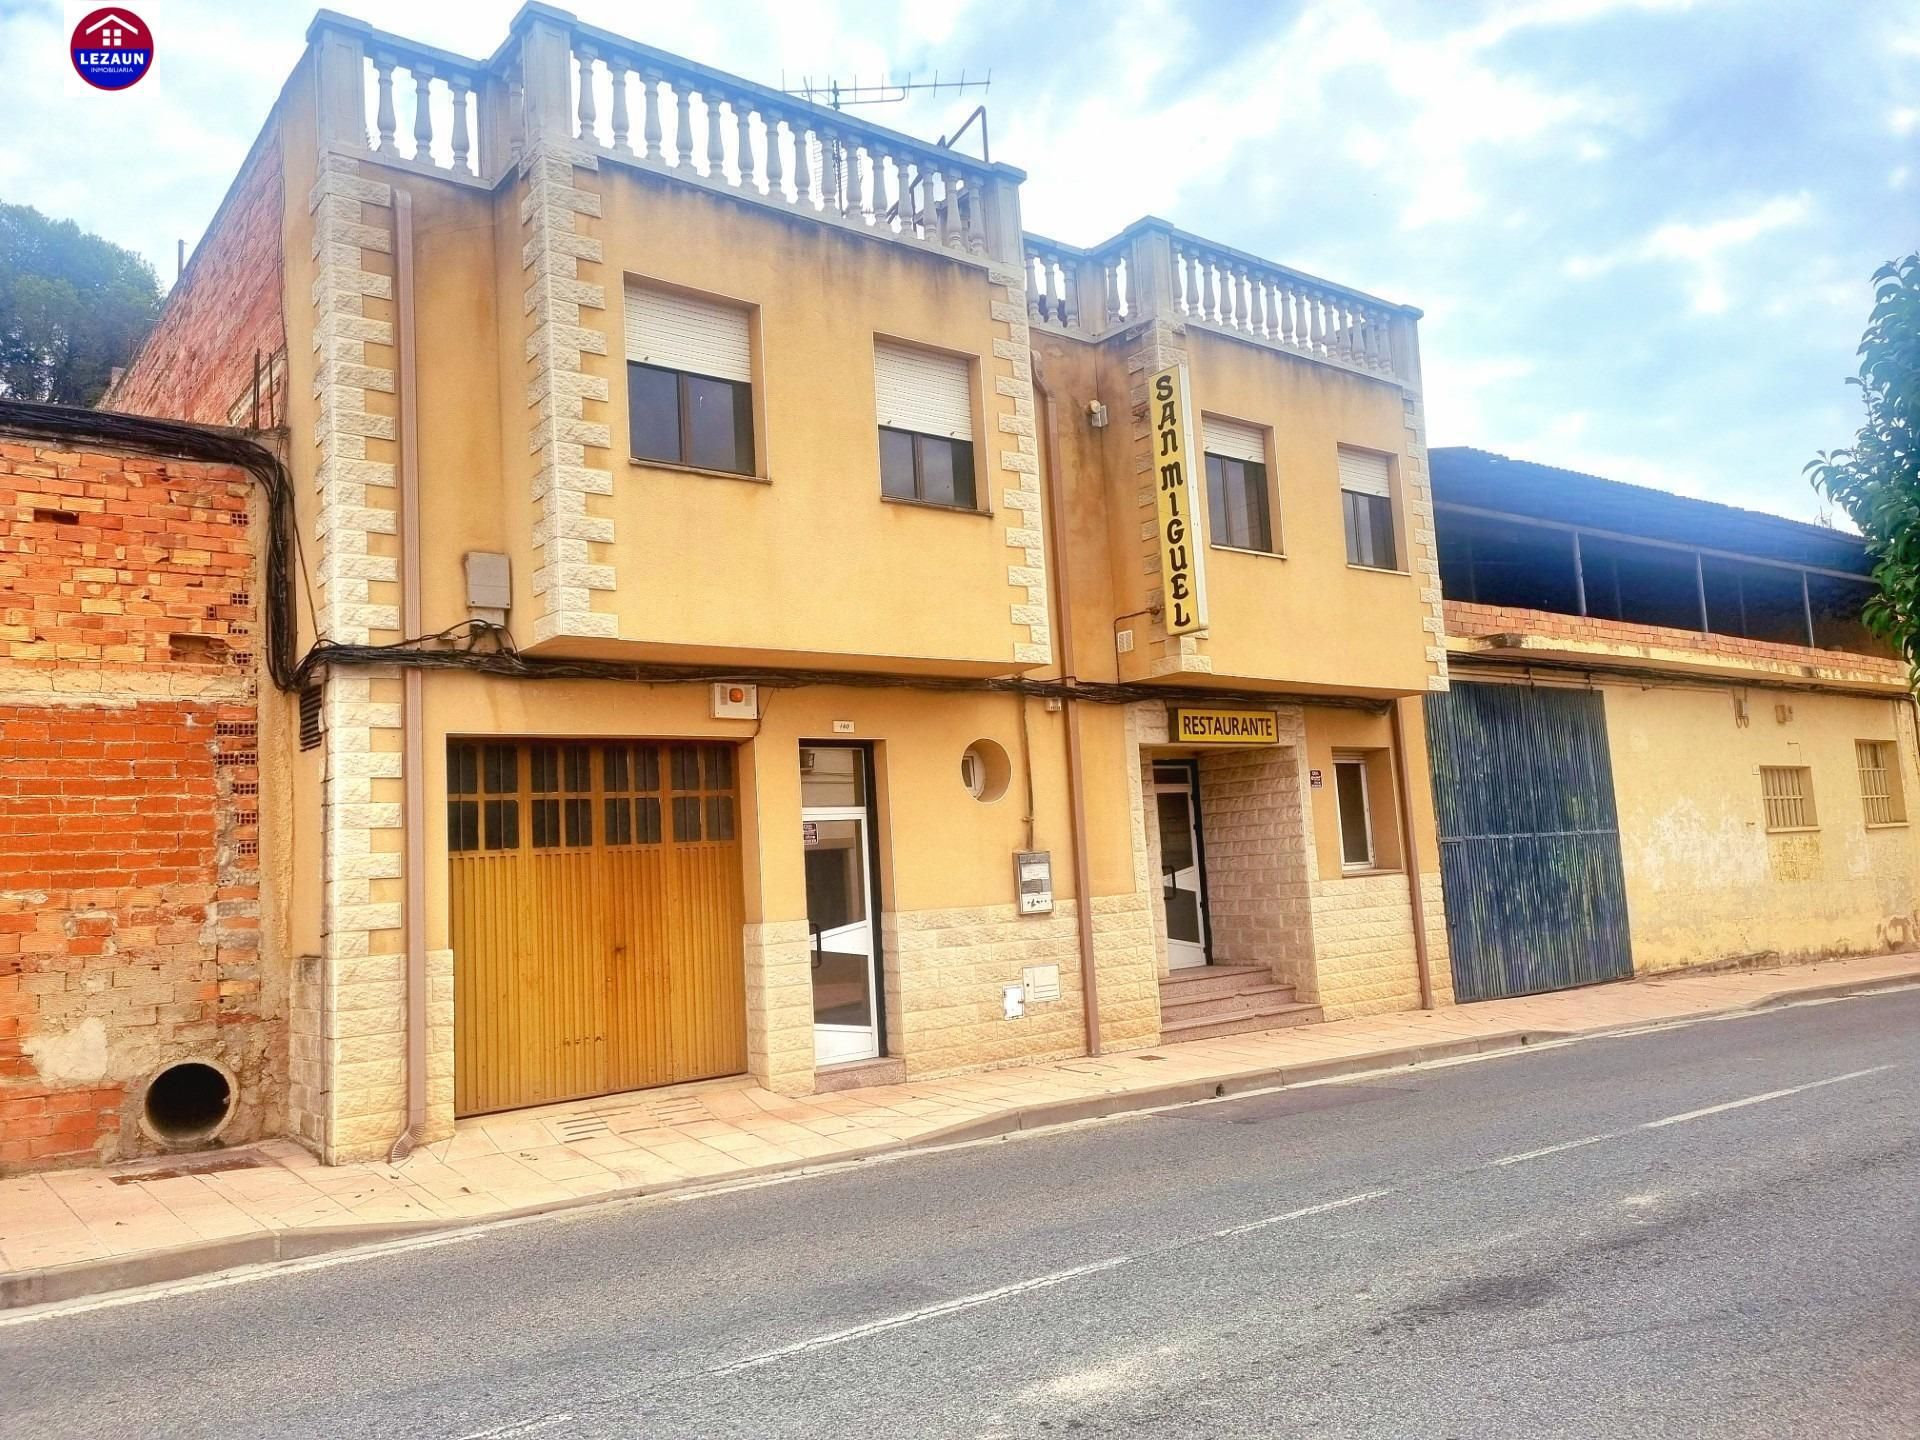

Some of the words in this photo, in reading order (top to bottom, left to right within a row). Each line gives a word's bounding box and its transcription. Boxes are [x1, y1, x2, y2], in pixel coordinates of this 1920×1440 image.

[1155, 375, 1178, 456] SAN
[1161, 461, 1190, 627] MIGUEL
[1183, 715, 1272, 736] RESTAURANTE
